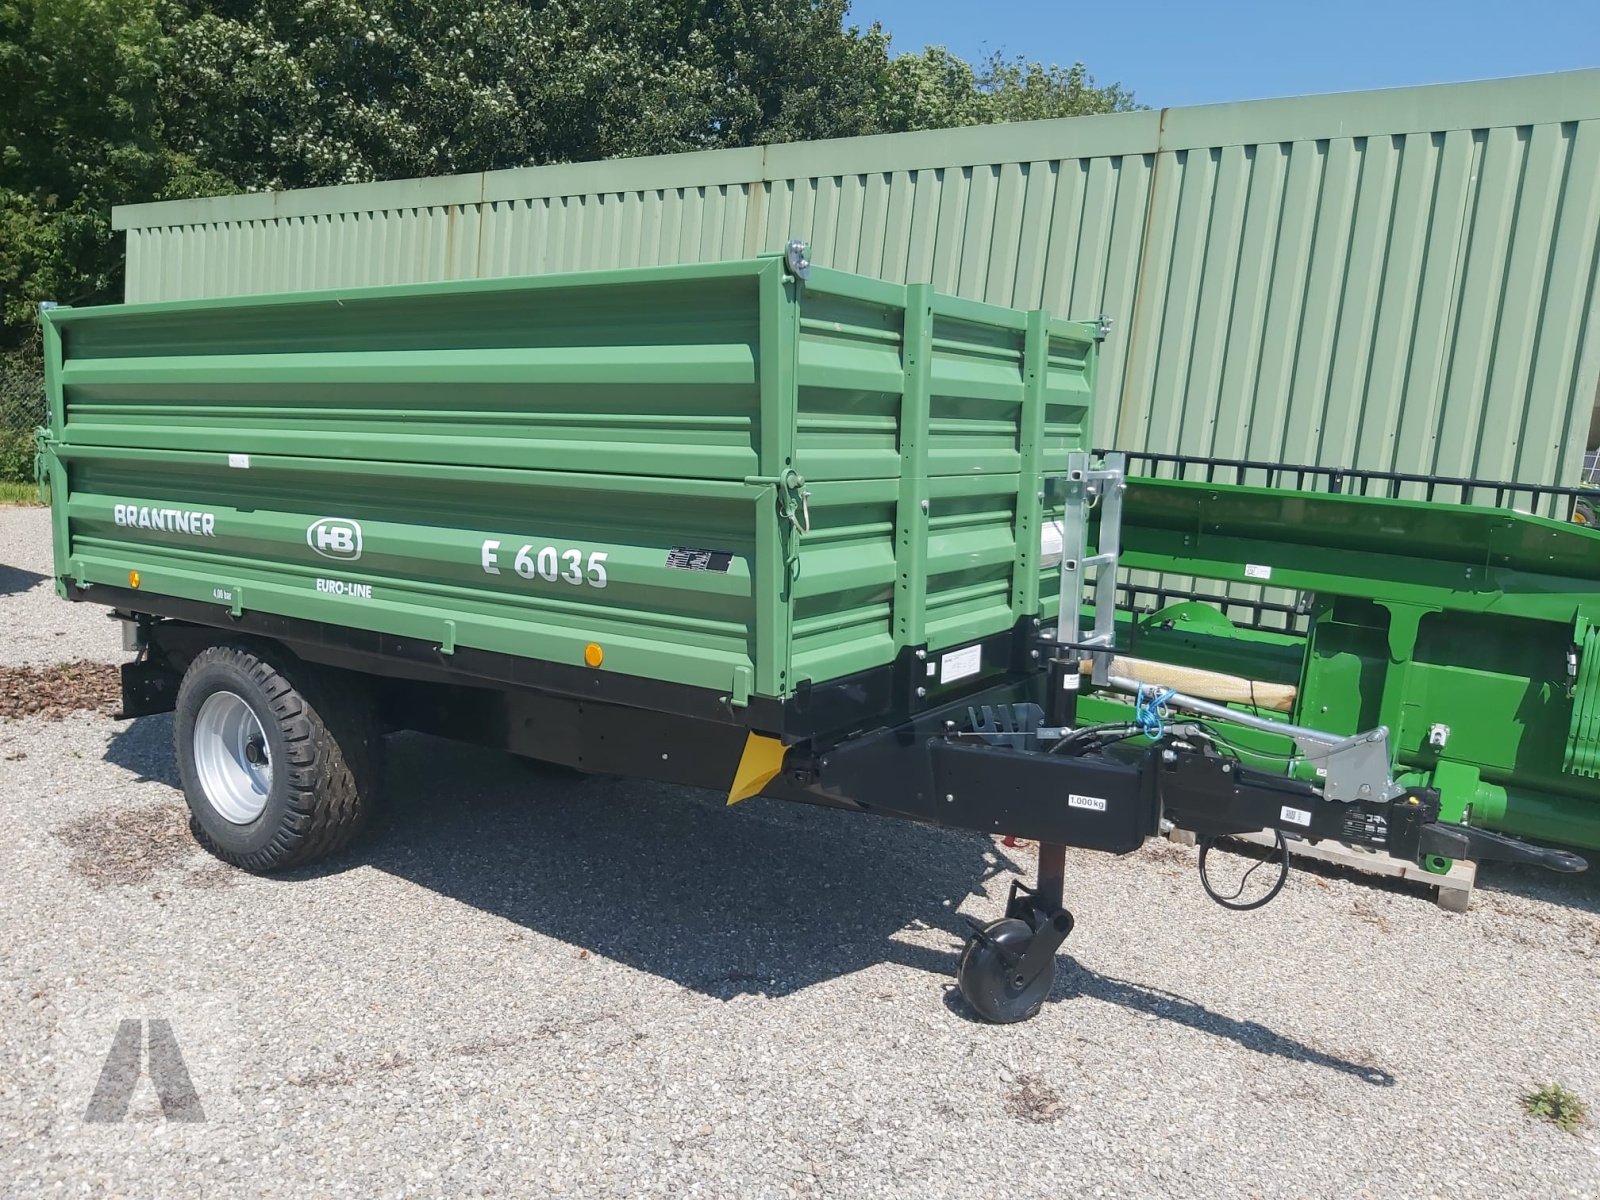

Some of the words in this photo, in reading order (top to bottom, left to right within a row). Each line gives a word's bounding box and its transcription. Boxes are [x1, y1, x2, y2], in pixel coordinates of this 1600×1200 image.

[114, 504, 216, 537] BRANTNER
[317, 525, 355, 553] HB
[481, 540, 501, 575] E
[514, 544, 609, 589] 6035
[316, 578, 372, 599] EURO-LINE
